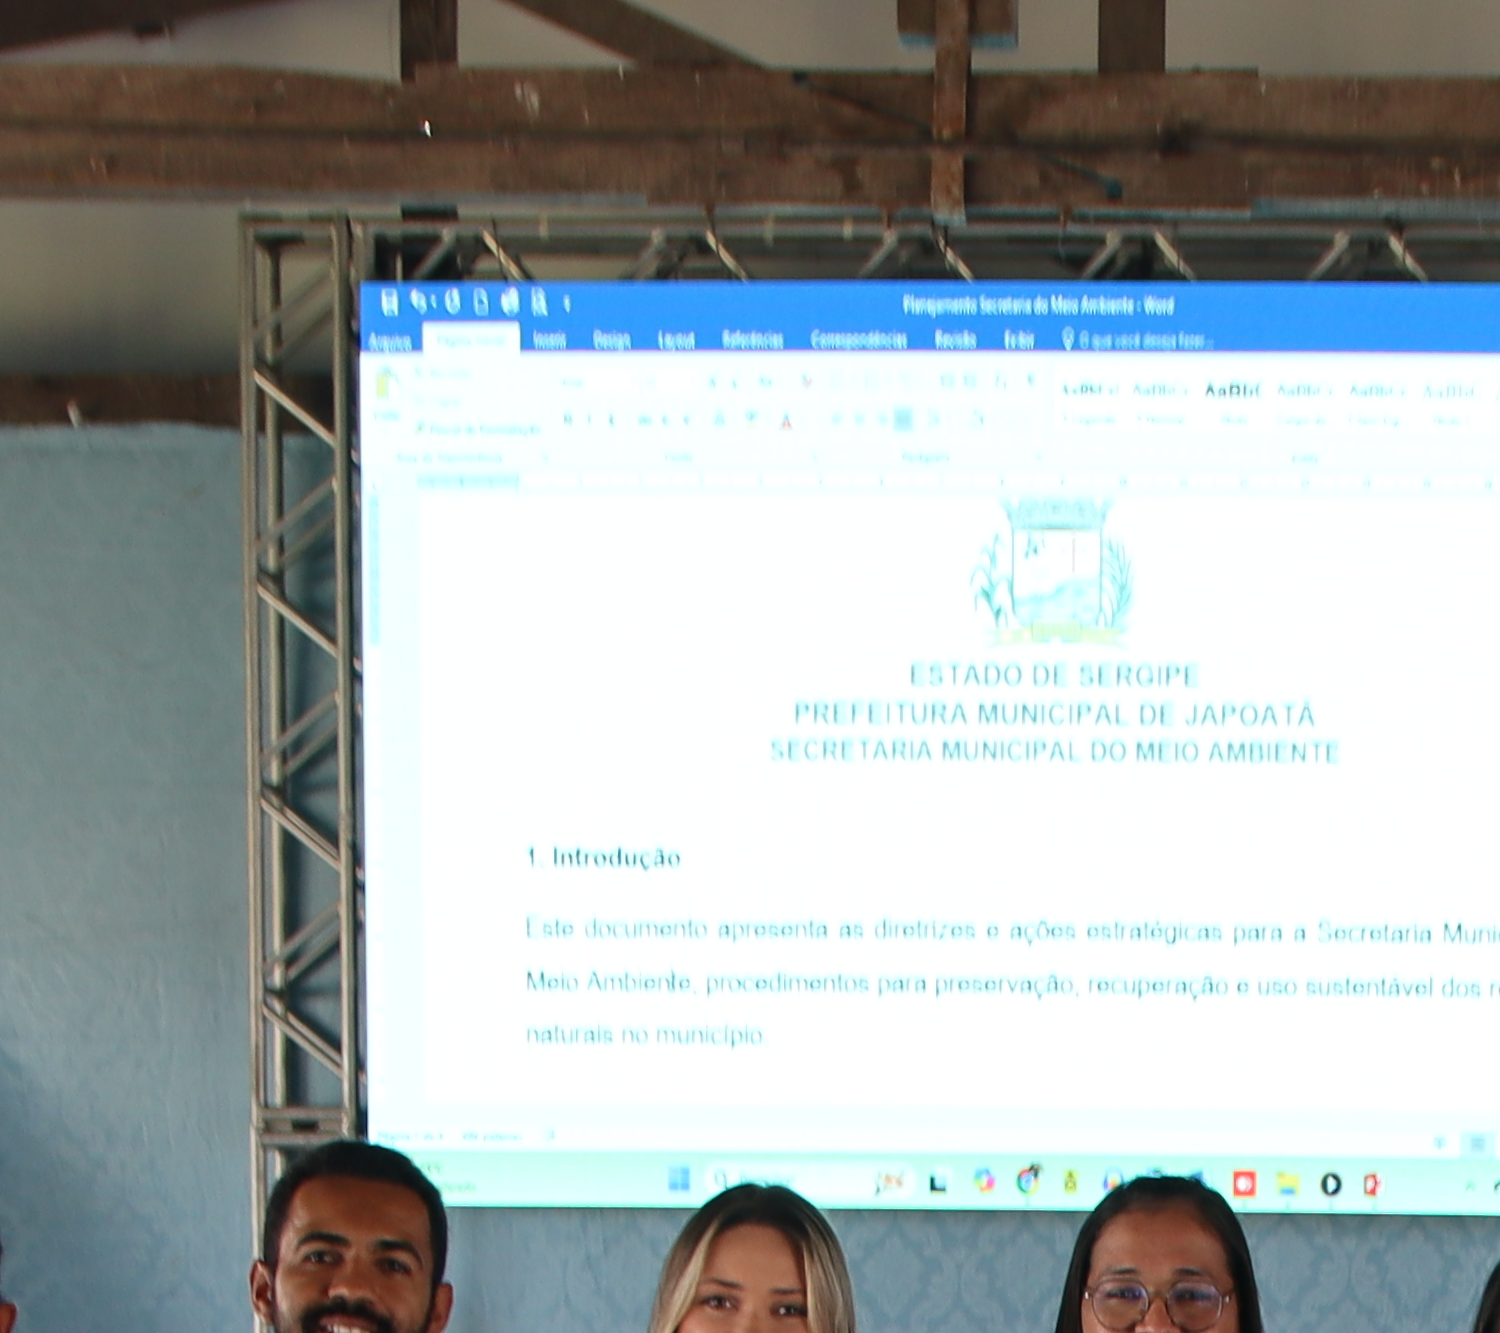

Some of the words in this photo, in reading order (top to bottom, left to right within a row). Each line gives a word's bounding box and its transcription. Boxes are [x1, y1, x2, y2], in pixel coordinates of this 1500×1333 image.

[1050, 295, 1078, 316] Meio
[1080, 295, 1134, 316] Ambiente
[1143, 295, 1175, 316] Word
[593, 330, 632, 352] Design
[658, 330, 695, 352] Layout
[909, 662, 1023, 688] ESTADO
[1032, 662, 1068, 688] DE
[1079, 662, 1200, 688] SERGIPE
[794, 699, 968, 727] PREFEITURA
[978, 700, 1129, 727] MUNICIPAL
[1139, 701, 1175, 727] DE
[770, 736, 933, 763] SECRETARIA
[942, 737, 1081, 763] MUNICIPAL
[1090, 739, 1127, 763] DO
[1136, 740, 1200, 764] MEIO
[1208, 740, 1341, 764] AMBIENTE
[553, 846, 682, 873] Introdução
[526, 917, 575, 940] Este
[584, 917, 708, 941] documento
[717, 919, 829, 946] apresenta
[839, 922, 864, 941] as
[875, 917, 976, 942] diretrizes
[986, 924, 999, 941] e
[1009, 919, 1076, 948] ações
[1086, 919, 1223, 946] estratégicas
[1233, 923, 1283, 948] para
[1293, 925, 1307, 942] a
[1317, 920, 1432, 945] Secretaria
[526, 969, 579, 994] Meio
[706, 971, 870, 998] procedimentos
[878, 977, 927, 999] para
[1088, 975, 1229, 1003] recuperação
[1236, 979, 1249, 995] e
[1257, 979, 1298, 997] uso
[1306, 976, 1434, 999] sustentável
[1442, 977, 1481, 999] dos
[526, 1024, 613, 1046] naturais
[621, 1027, 649, 1046] no
